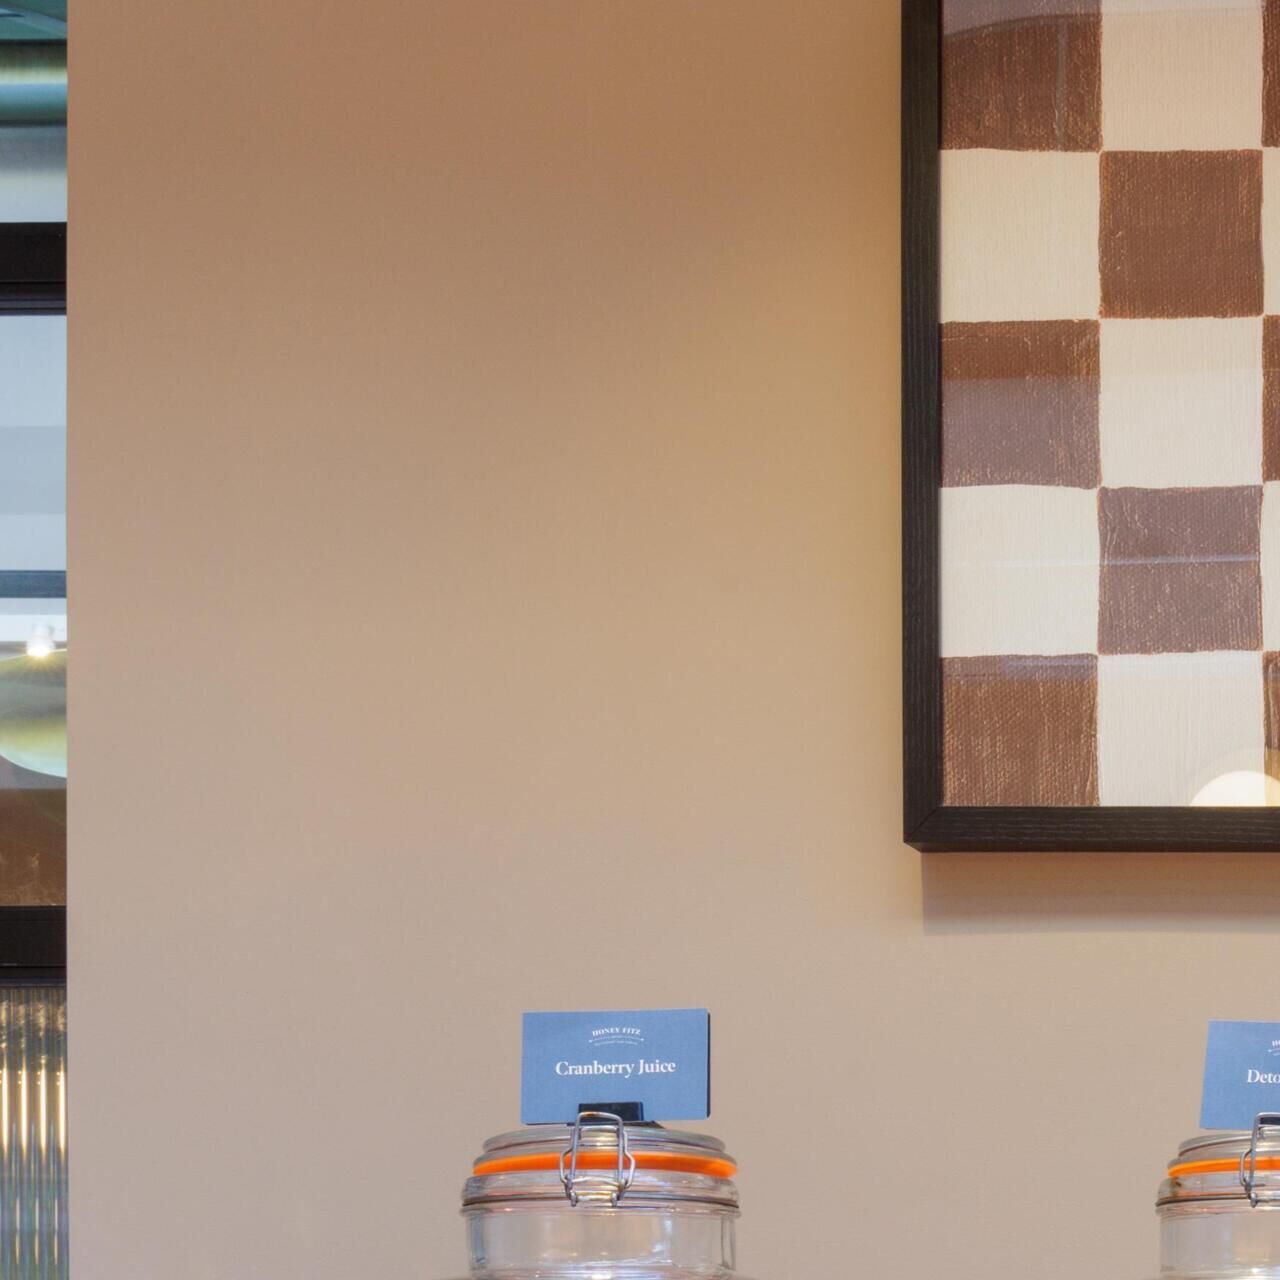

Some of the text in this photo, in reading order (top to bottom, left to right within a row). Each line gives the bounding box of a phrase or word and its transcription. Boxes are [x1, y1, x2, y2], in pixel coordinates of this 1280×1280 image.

[592, 1026, 641, 1037] HONEY FITZ
[555, 1058, 676, 1078] Cranberry Juice
